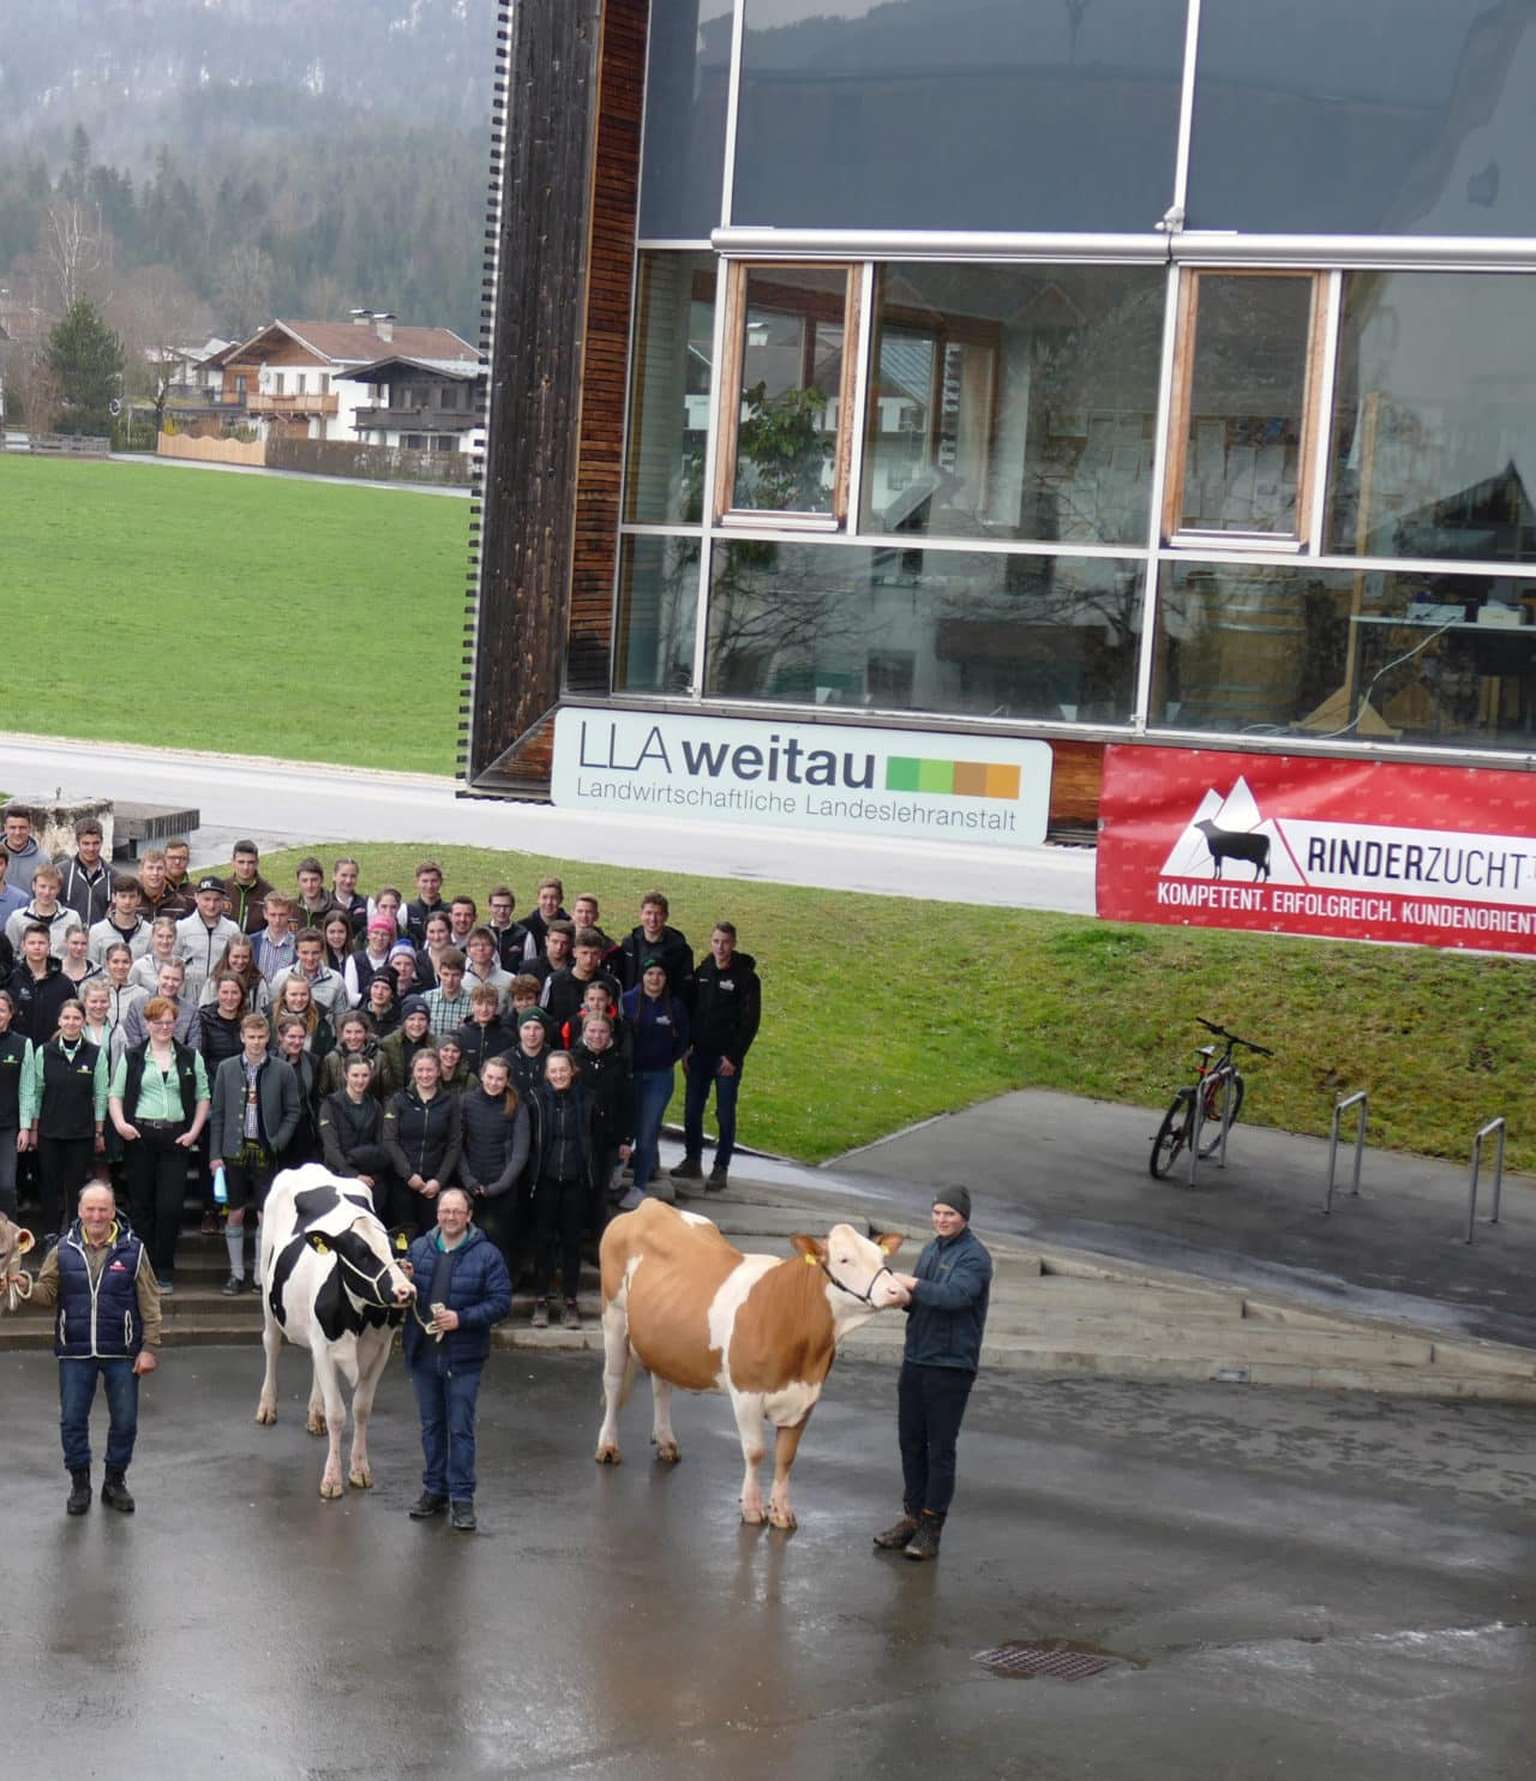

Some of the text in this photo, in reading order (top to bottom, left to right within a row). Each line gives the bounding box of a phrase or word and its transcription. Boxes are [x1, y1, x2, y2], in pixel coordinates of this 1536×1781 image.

[578, 720, 876, 790] LLA weitau
[576, 777, 1017, 832] Landwirtschaftliche Landeslehranstalt
[1307, 836, 1528, 890] RINDERZUCHT
[1156, 882, 1268, 913] KOMPETENT.
[1272, 890, 1398, 923] ERFOLGREICH.
